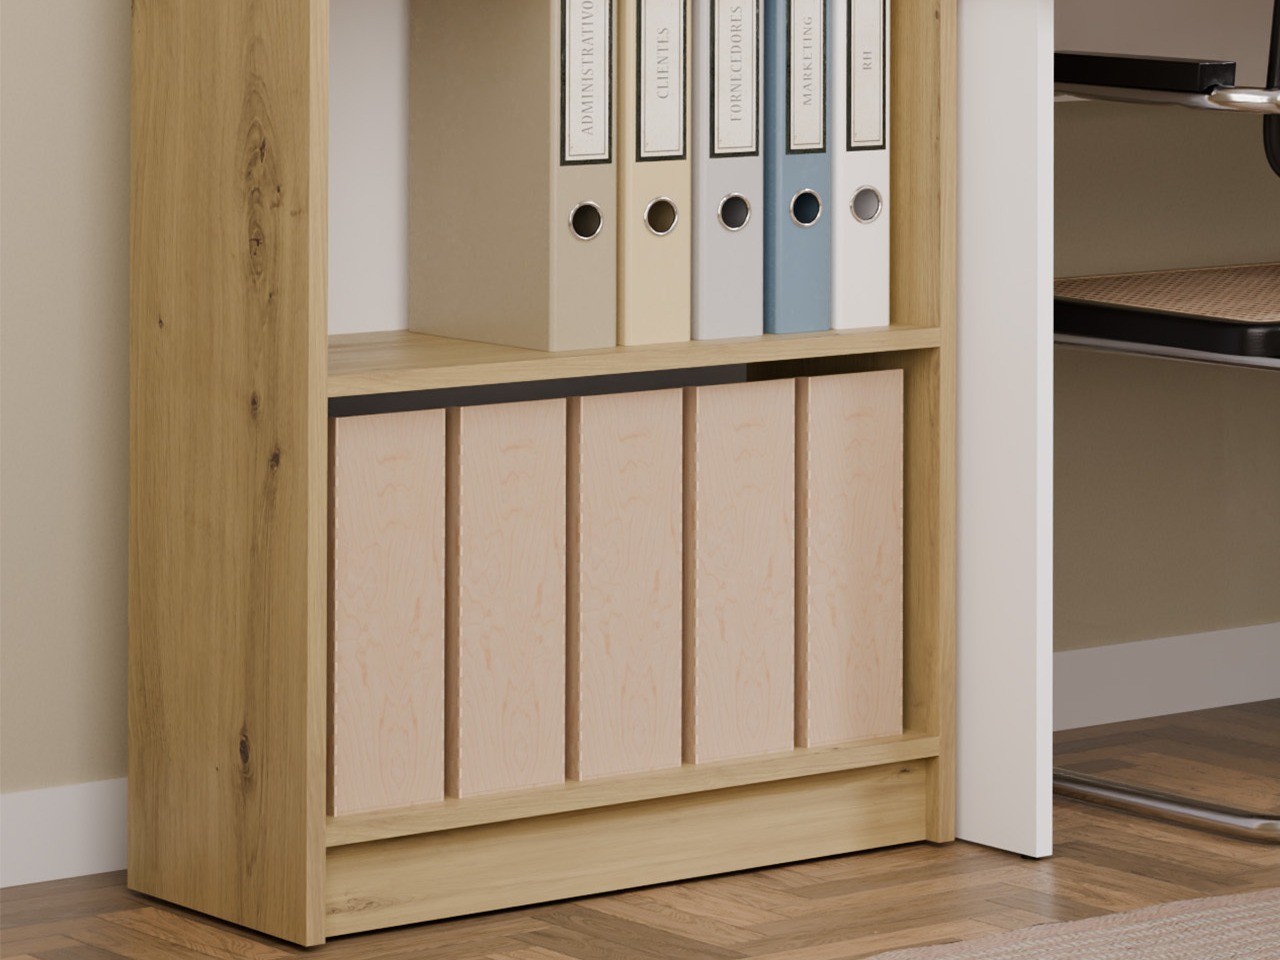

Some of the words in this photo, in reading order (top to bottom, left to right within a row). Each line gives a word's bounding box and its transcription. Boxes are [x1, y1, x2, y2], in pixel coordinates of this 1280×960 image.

[581, 0, 594, 135] ADMINISTRATIVO
[657, 27, 669, 99] CLIENTES
[730, 5, 742, 122] FORNECEDORES
[802, 15, 813, 106] MARKETING
[862, 50, 872, 70] RH
